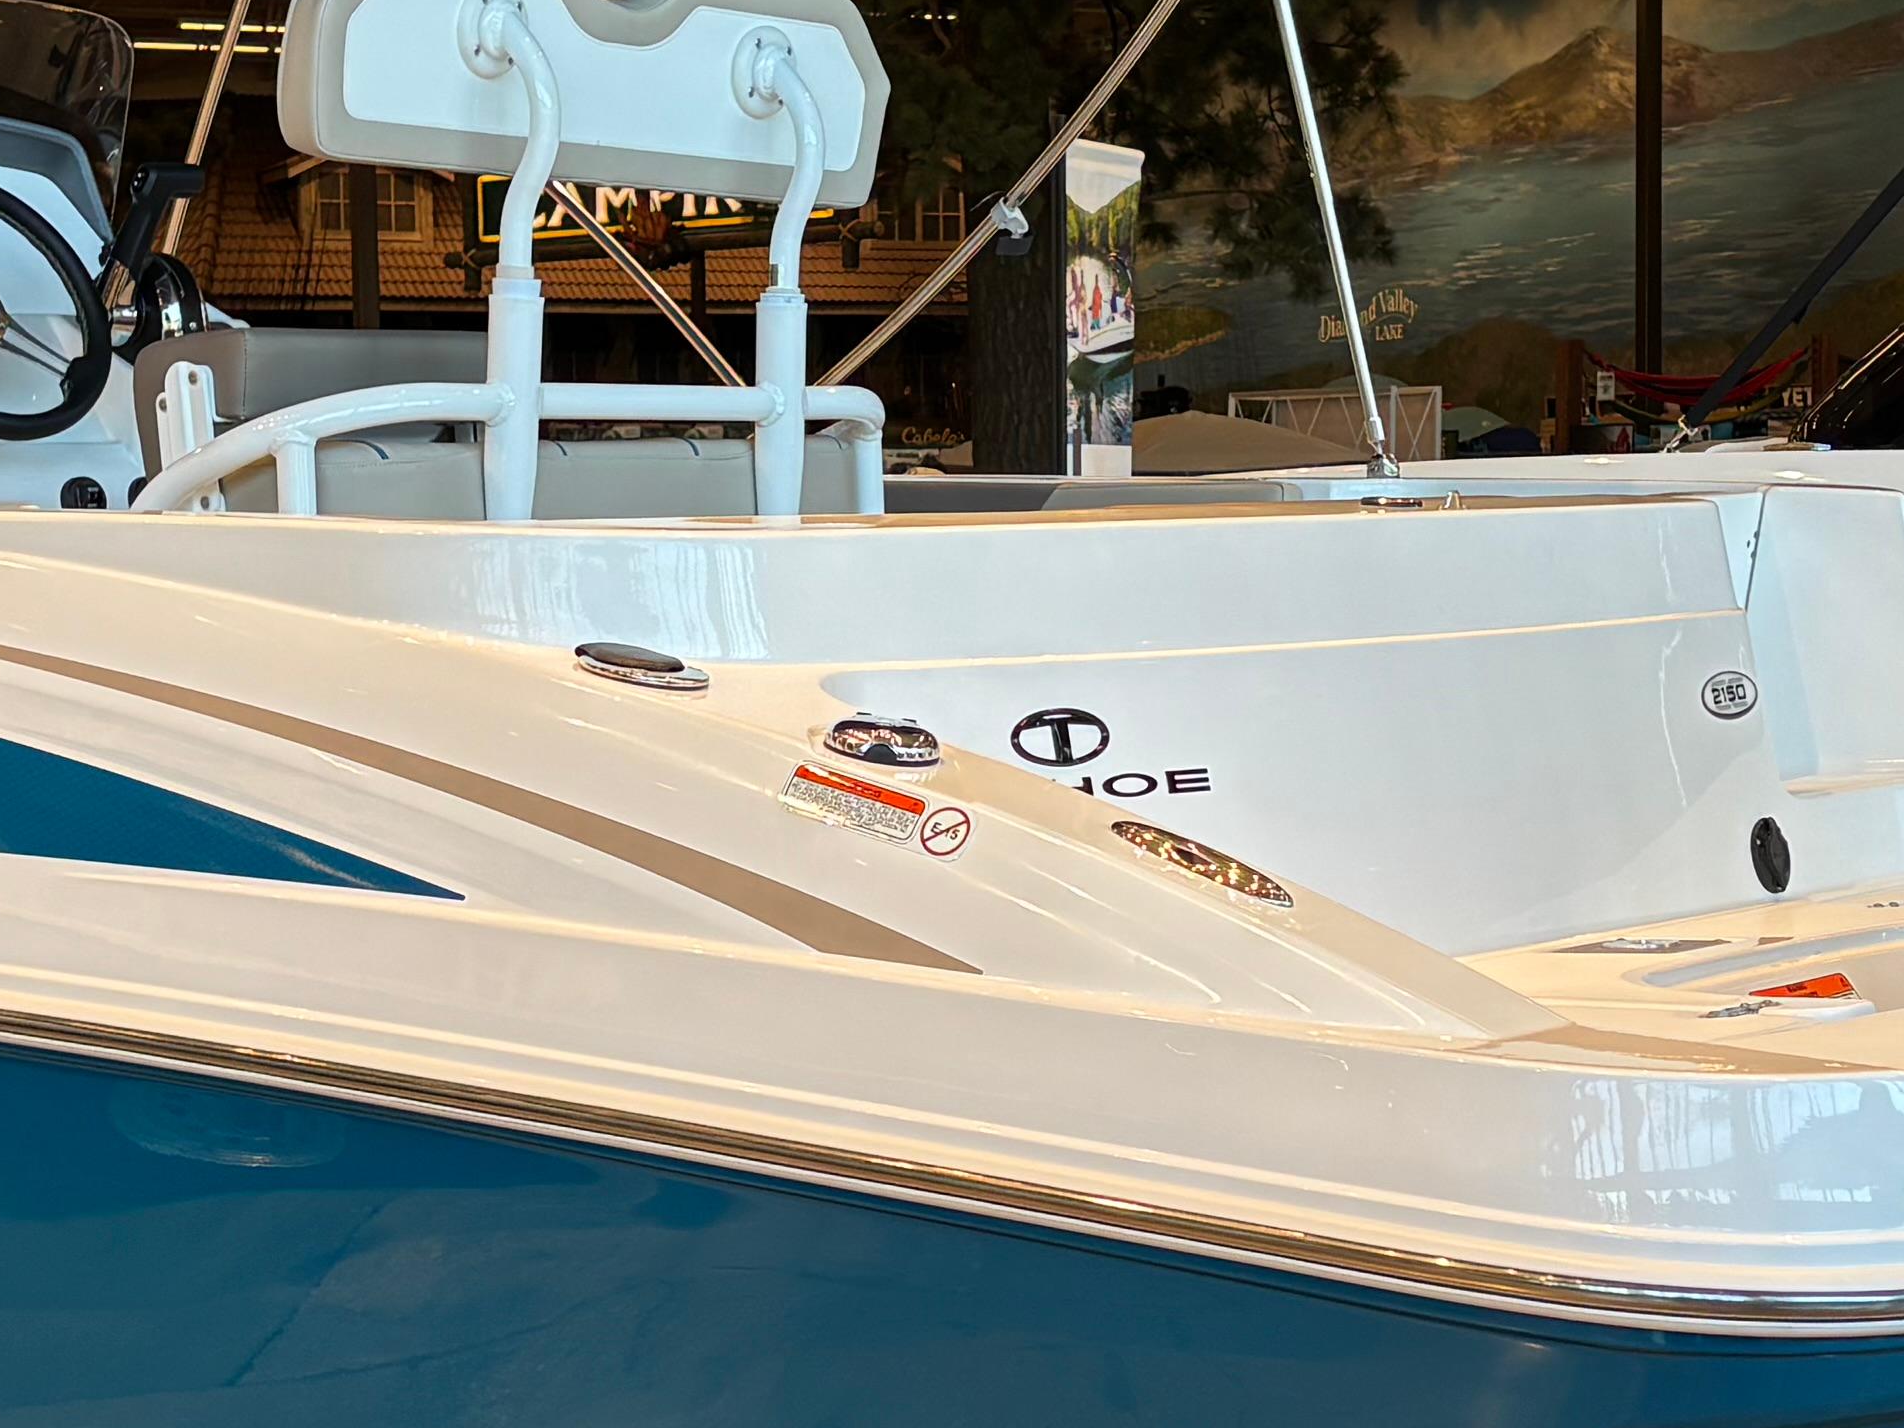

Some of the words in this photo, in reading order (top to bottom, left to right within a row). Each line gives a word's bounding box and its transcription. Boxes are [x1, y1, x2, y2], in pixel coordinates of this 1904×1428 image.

[1318, 295, 1377, 343] Diand
[1377, 288, 1419, 324] Valley
[1375, 323, 1404, 341] LAKE
[1711, 683, 1747, 705] 2150
